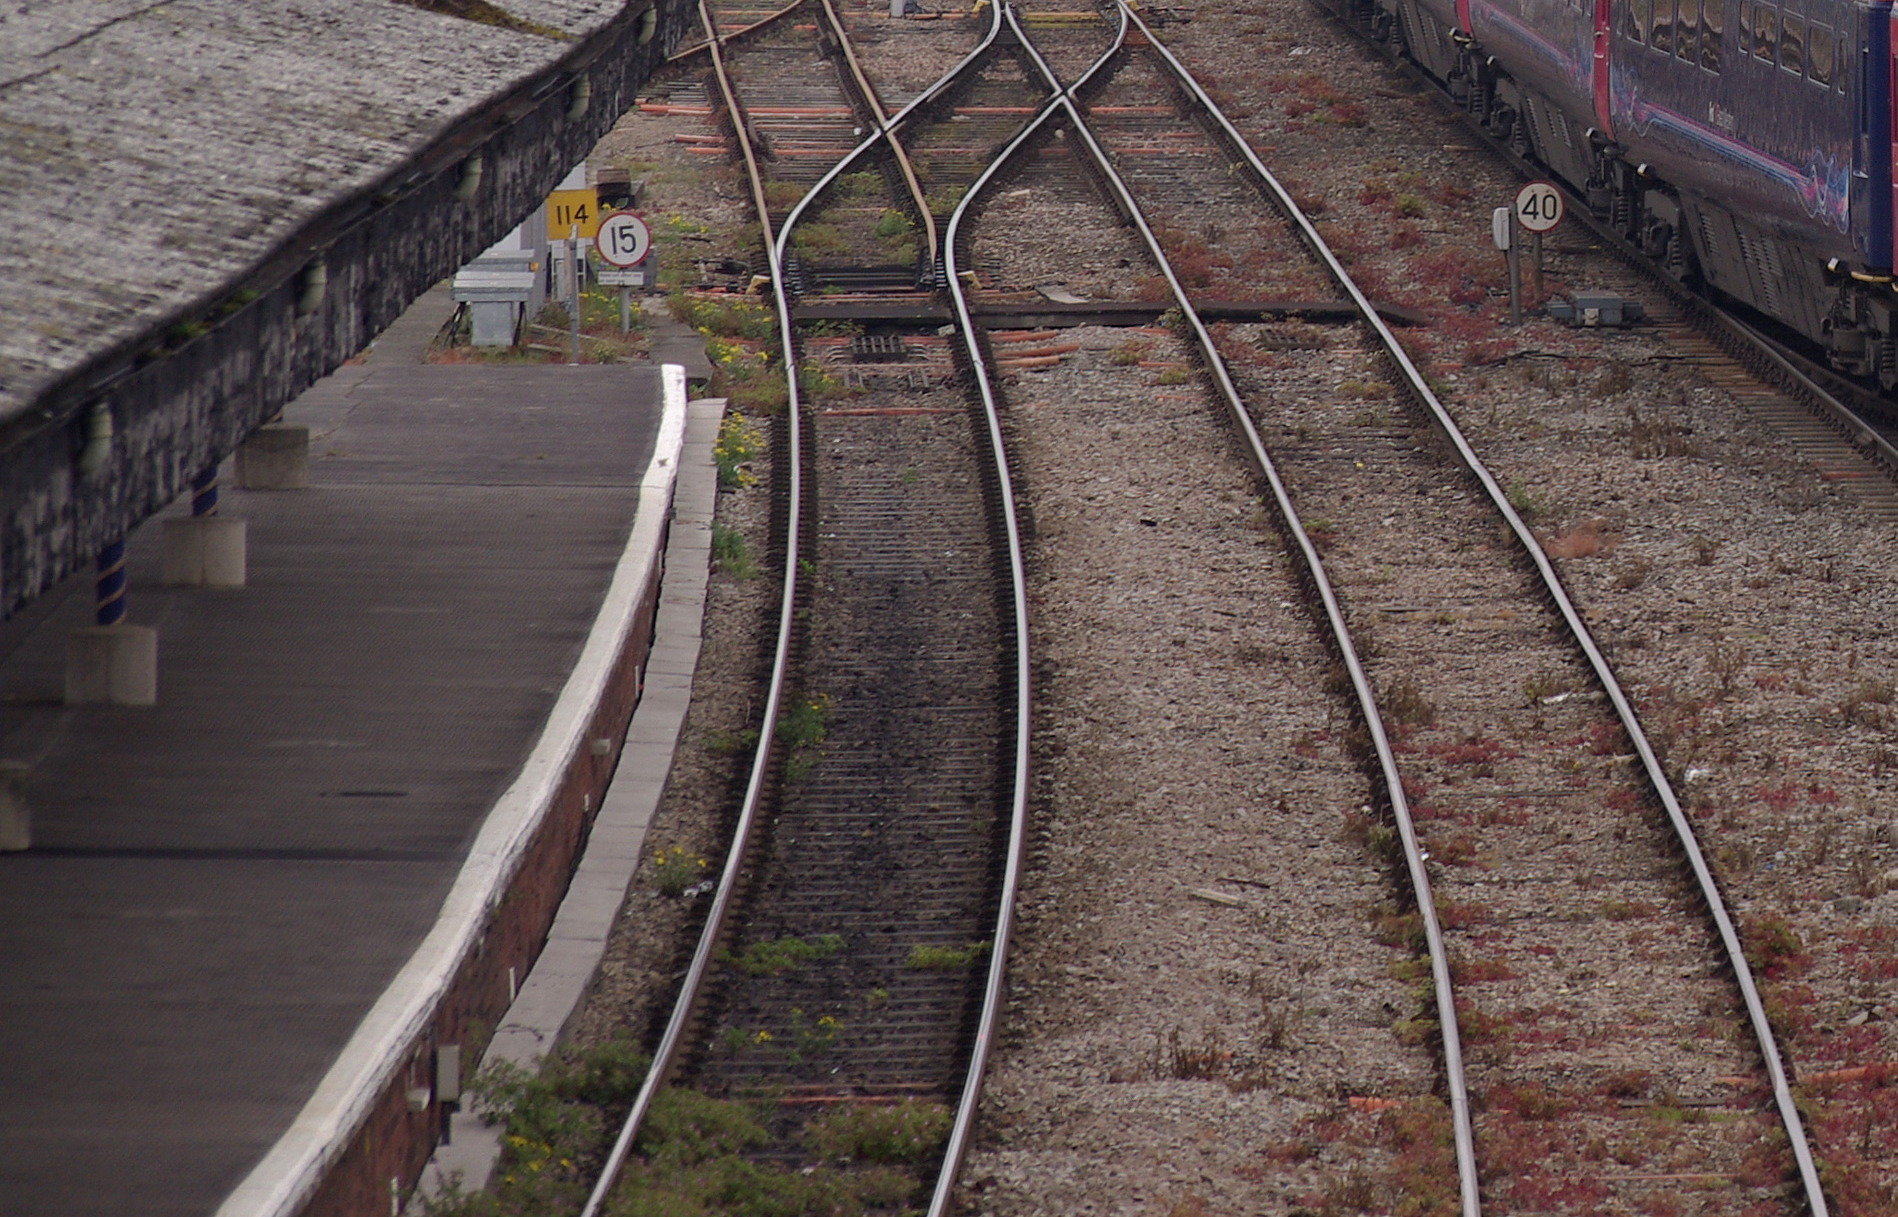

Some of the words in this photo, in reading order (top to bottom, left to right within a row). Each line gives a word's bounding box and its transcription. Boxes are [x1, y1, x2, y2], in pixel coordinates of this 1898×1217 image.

[556, 203, 590, 226] 114
[1521, 193, 1558, 221] 40
[610, 224, 637, 256] 15
